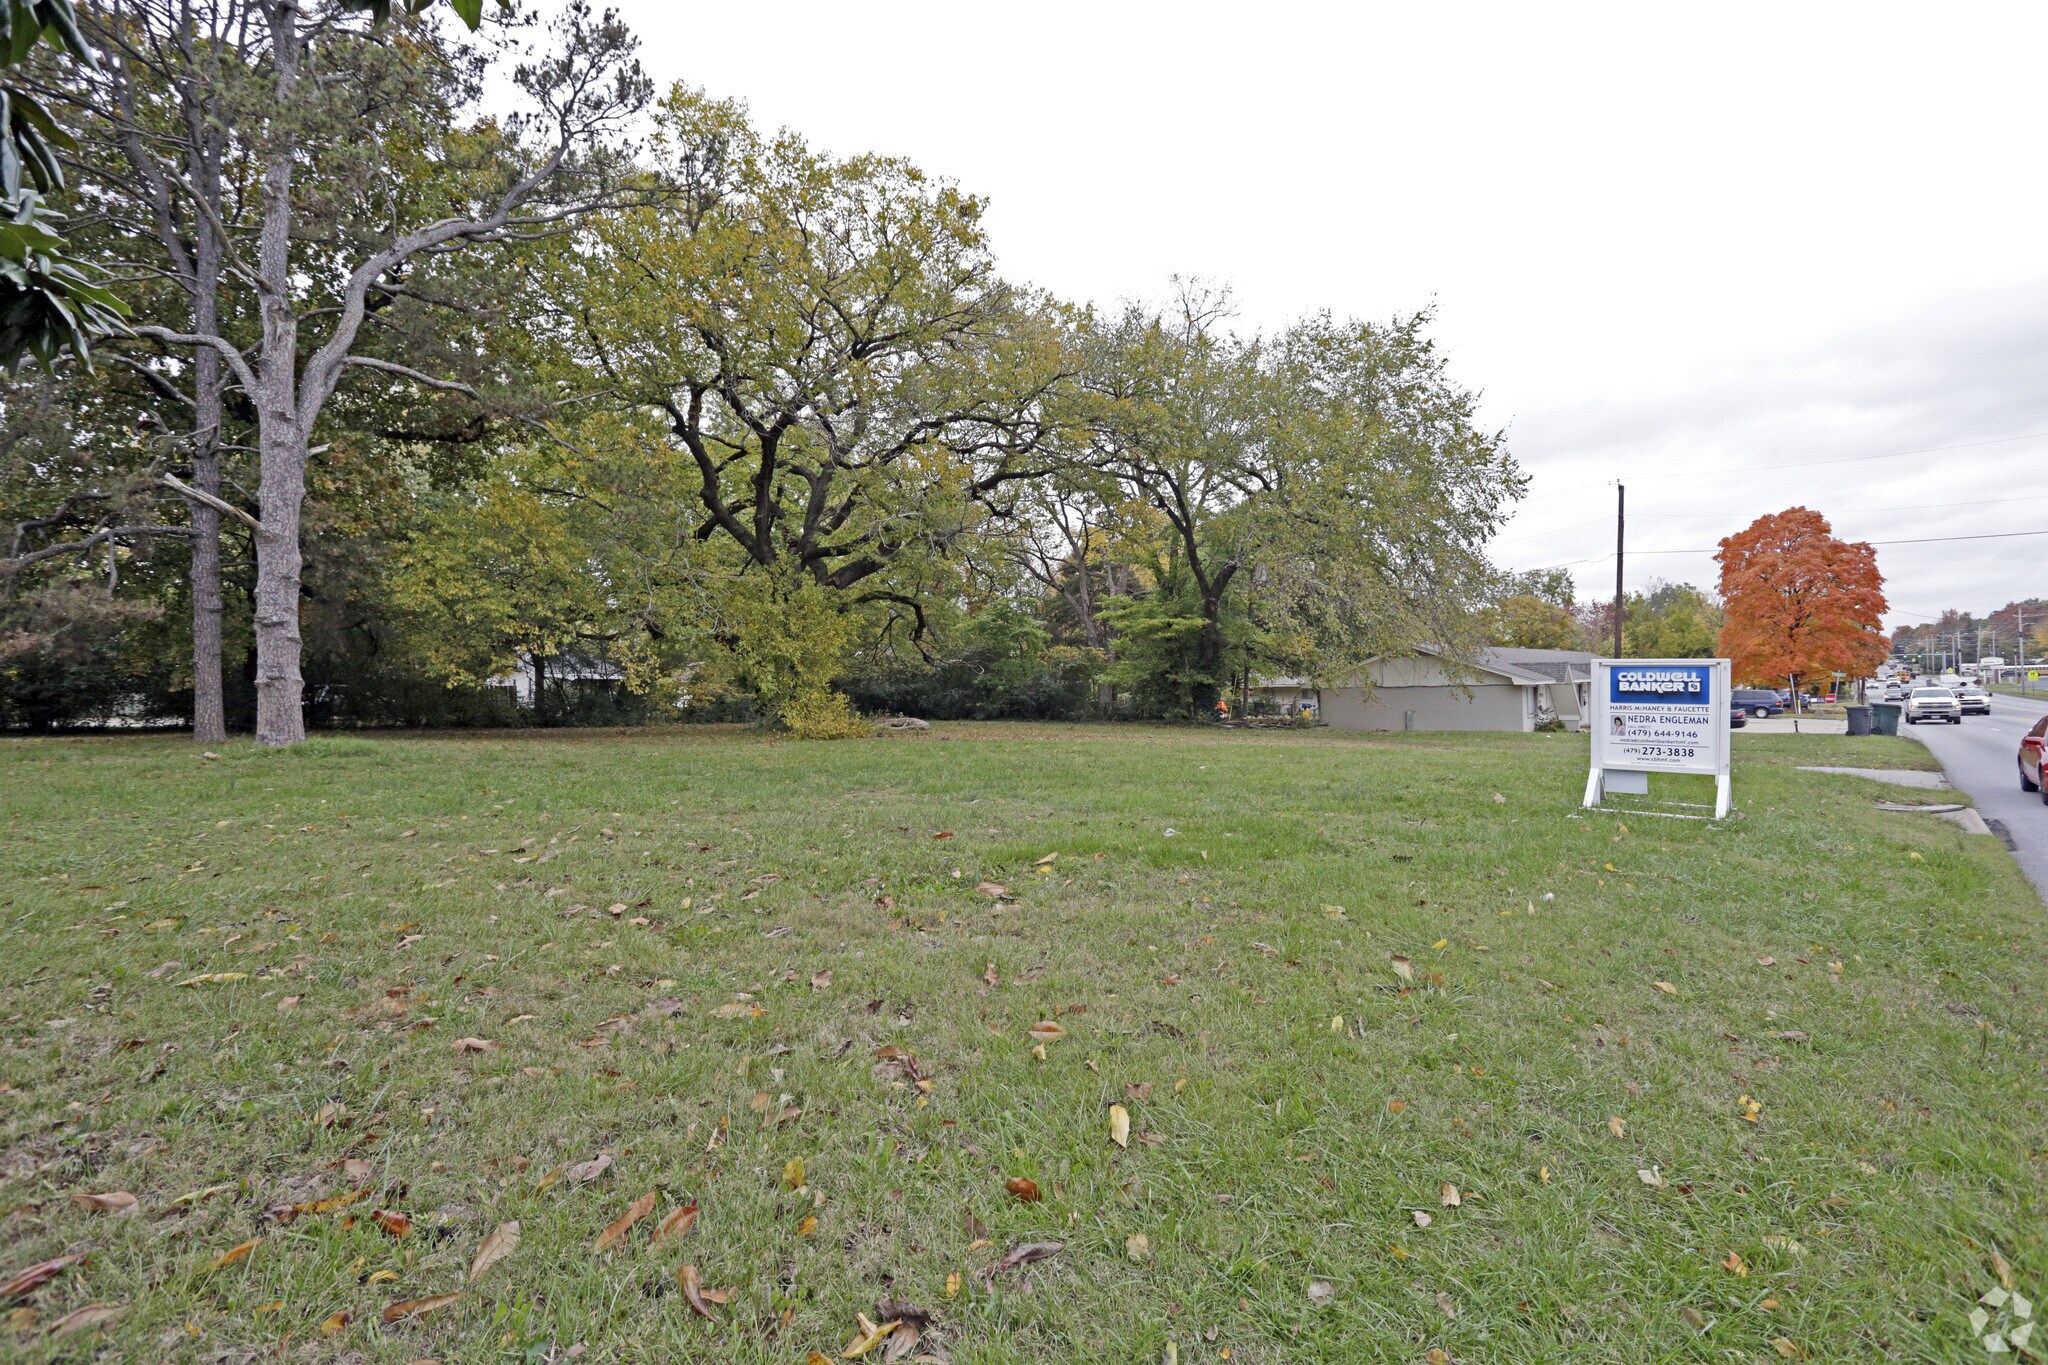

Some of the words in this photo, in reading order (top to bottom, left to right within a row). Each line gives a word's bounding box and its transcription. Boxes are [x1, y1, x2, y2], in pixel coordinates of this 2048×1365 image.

[1628, 715, 1656, 723] NEDRA
[1660, 716, 1708, 724] ENGLEMAN
[1628, 729, 1652, 737] (479)
[1654, 730, 1698, 738] 644-9146
[1642, 747, 1694, 757] 273-3838
